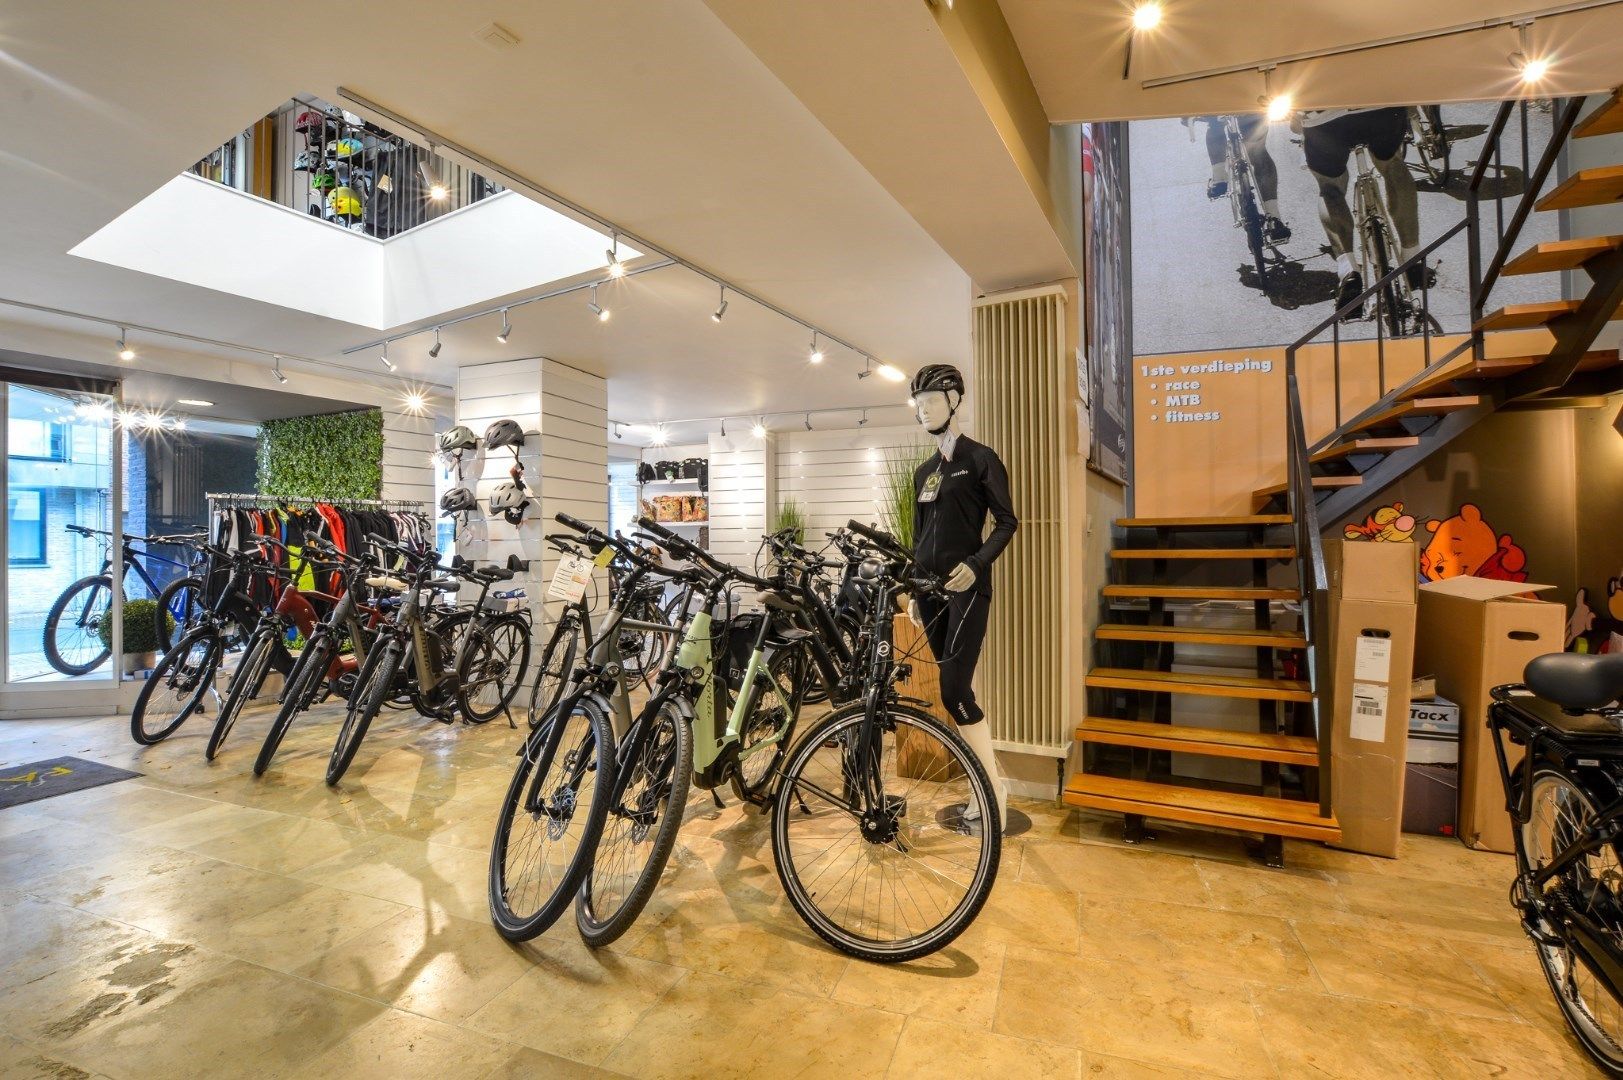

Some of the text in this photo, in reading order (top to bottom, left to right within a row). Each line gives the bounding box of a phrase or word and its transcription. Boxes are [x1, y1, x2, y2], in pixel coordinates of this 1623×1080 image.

[1141, 358, 1272, 377] 1ste verdieping
[1166, 380, 1200, 391] race
[1166, 394, 1200, 407] MTB
[1166, 410, 1220, 423] fitness
[1410, 709, 1449, 722] Tacx
